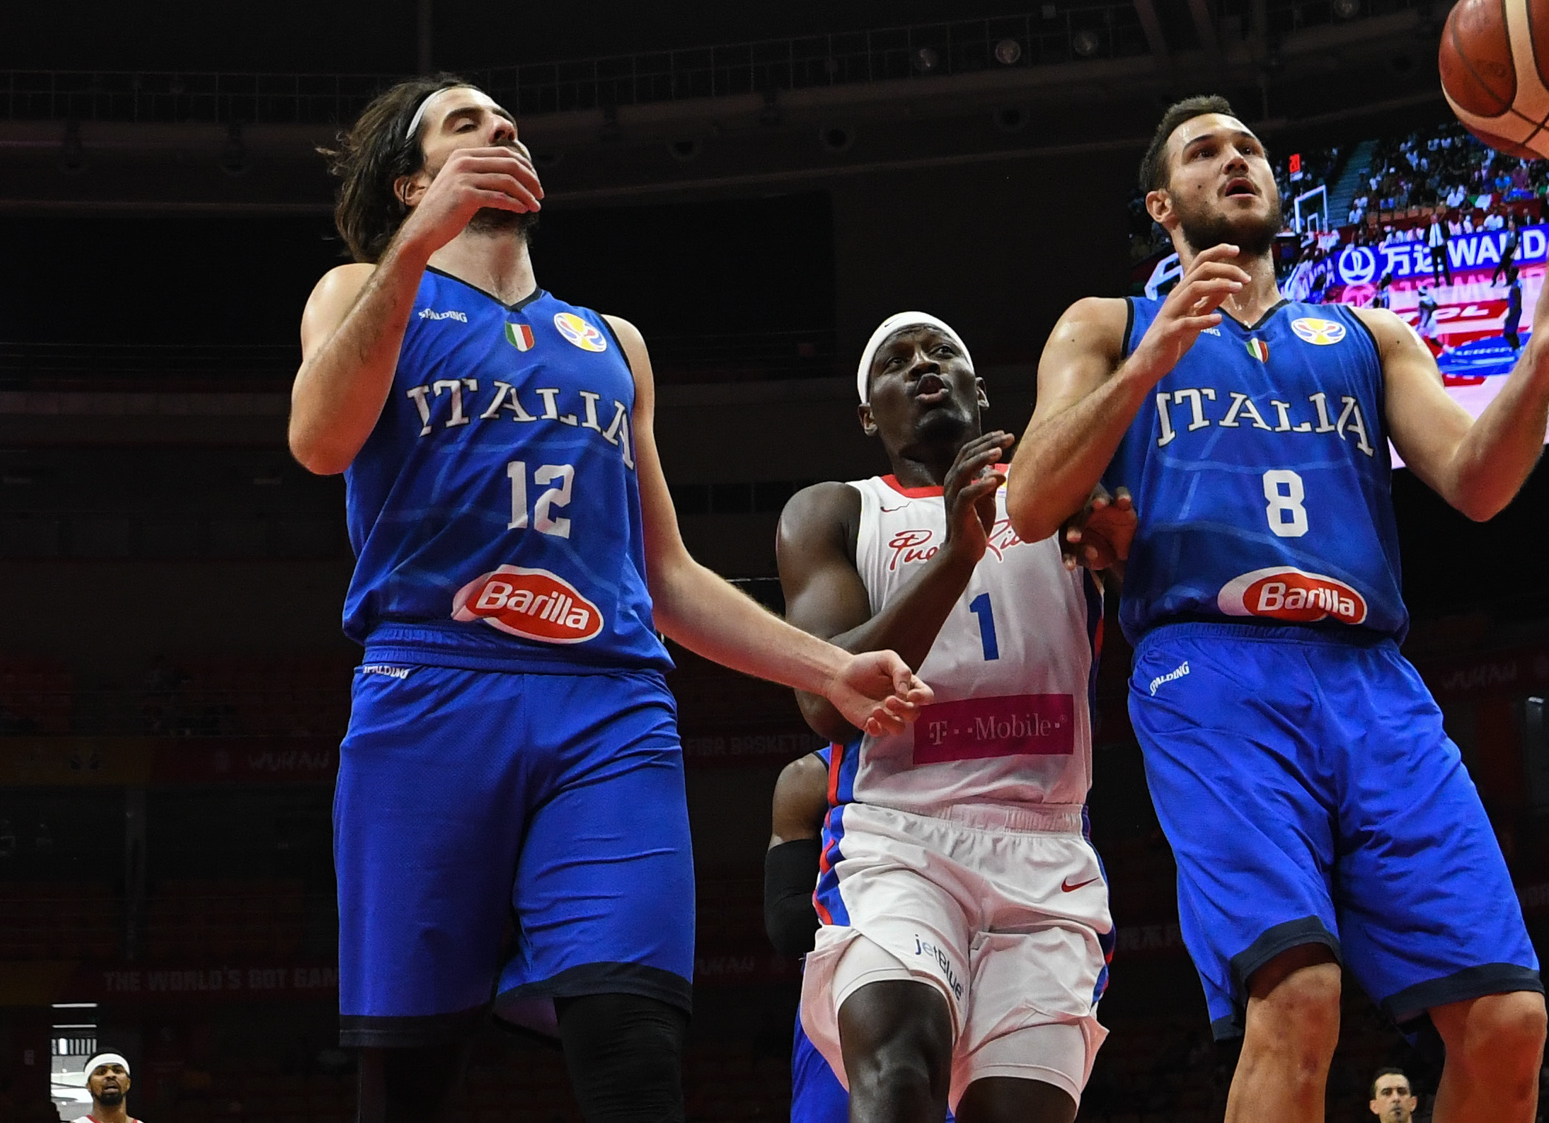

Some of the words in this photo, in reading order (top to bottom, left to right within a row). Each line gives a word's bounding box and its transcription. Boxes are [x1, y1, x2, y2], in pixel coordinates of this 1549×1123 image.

[405, 377, 635, 473] ITALIA
[1156, 387, 1375, 458] ITALIA
[506, 460, 576, 540] 12
[1262, 469, 1310, 538] 8
[475, 579, 591, 632] Barilla
[969, 592, 1000, 662] 1
[1257, 581, 1356, 618] Barilla
[1149, 660, 1190, 697] SPALDING
[103, 971, 141, 992] THE
[148, 965, 242, 991] WORLD'S
[294, 967, 340, 989] GAM
[914, 933, 963, 1002] jetBlue
